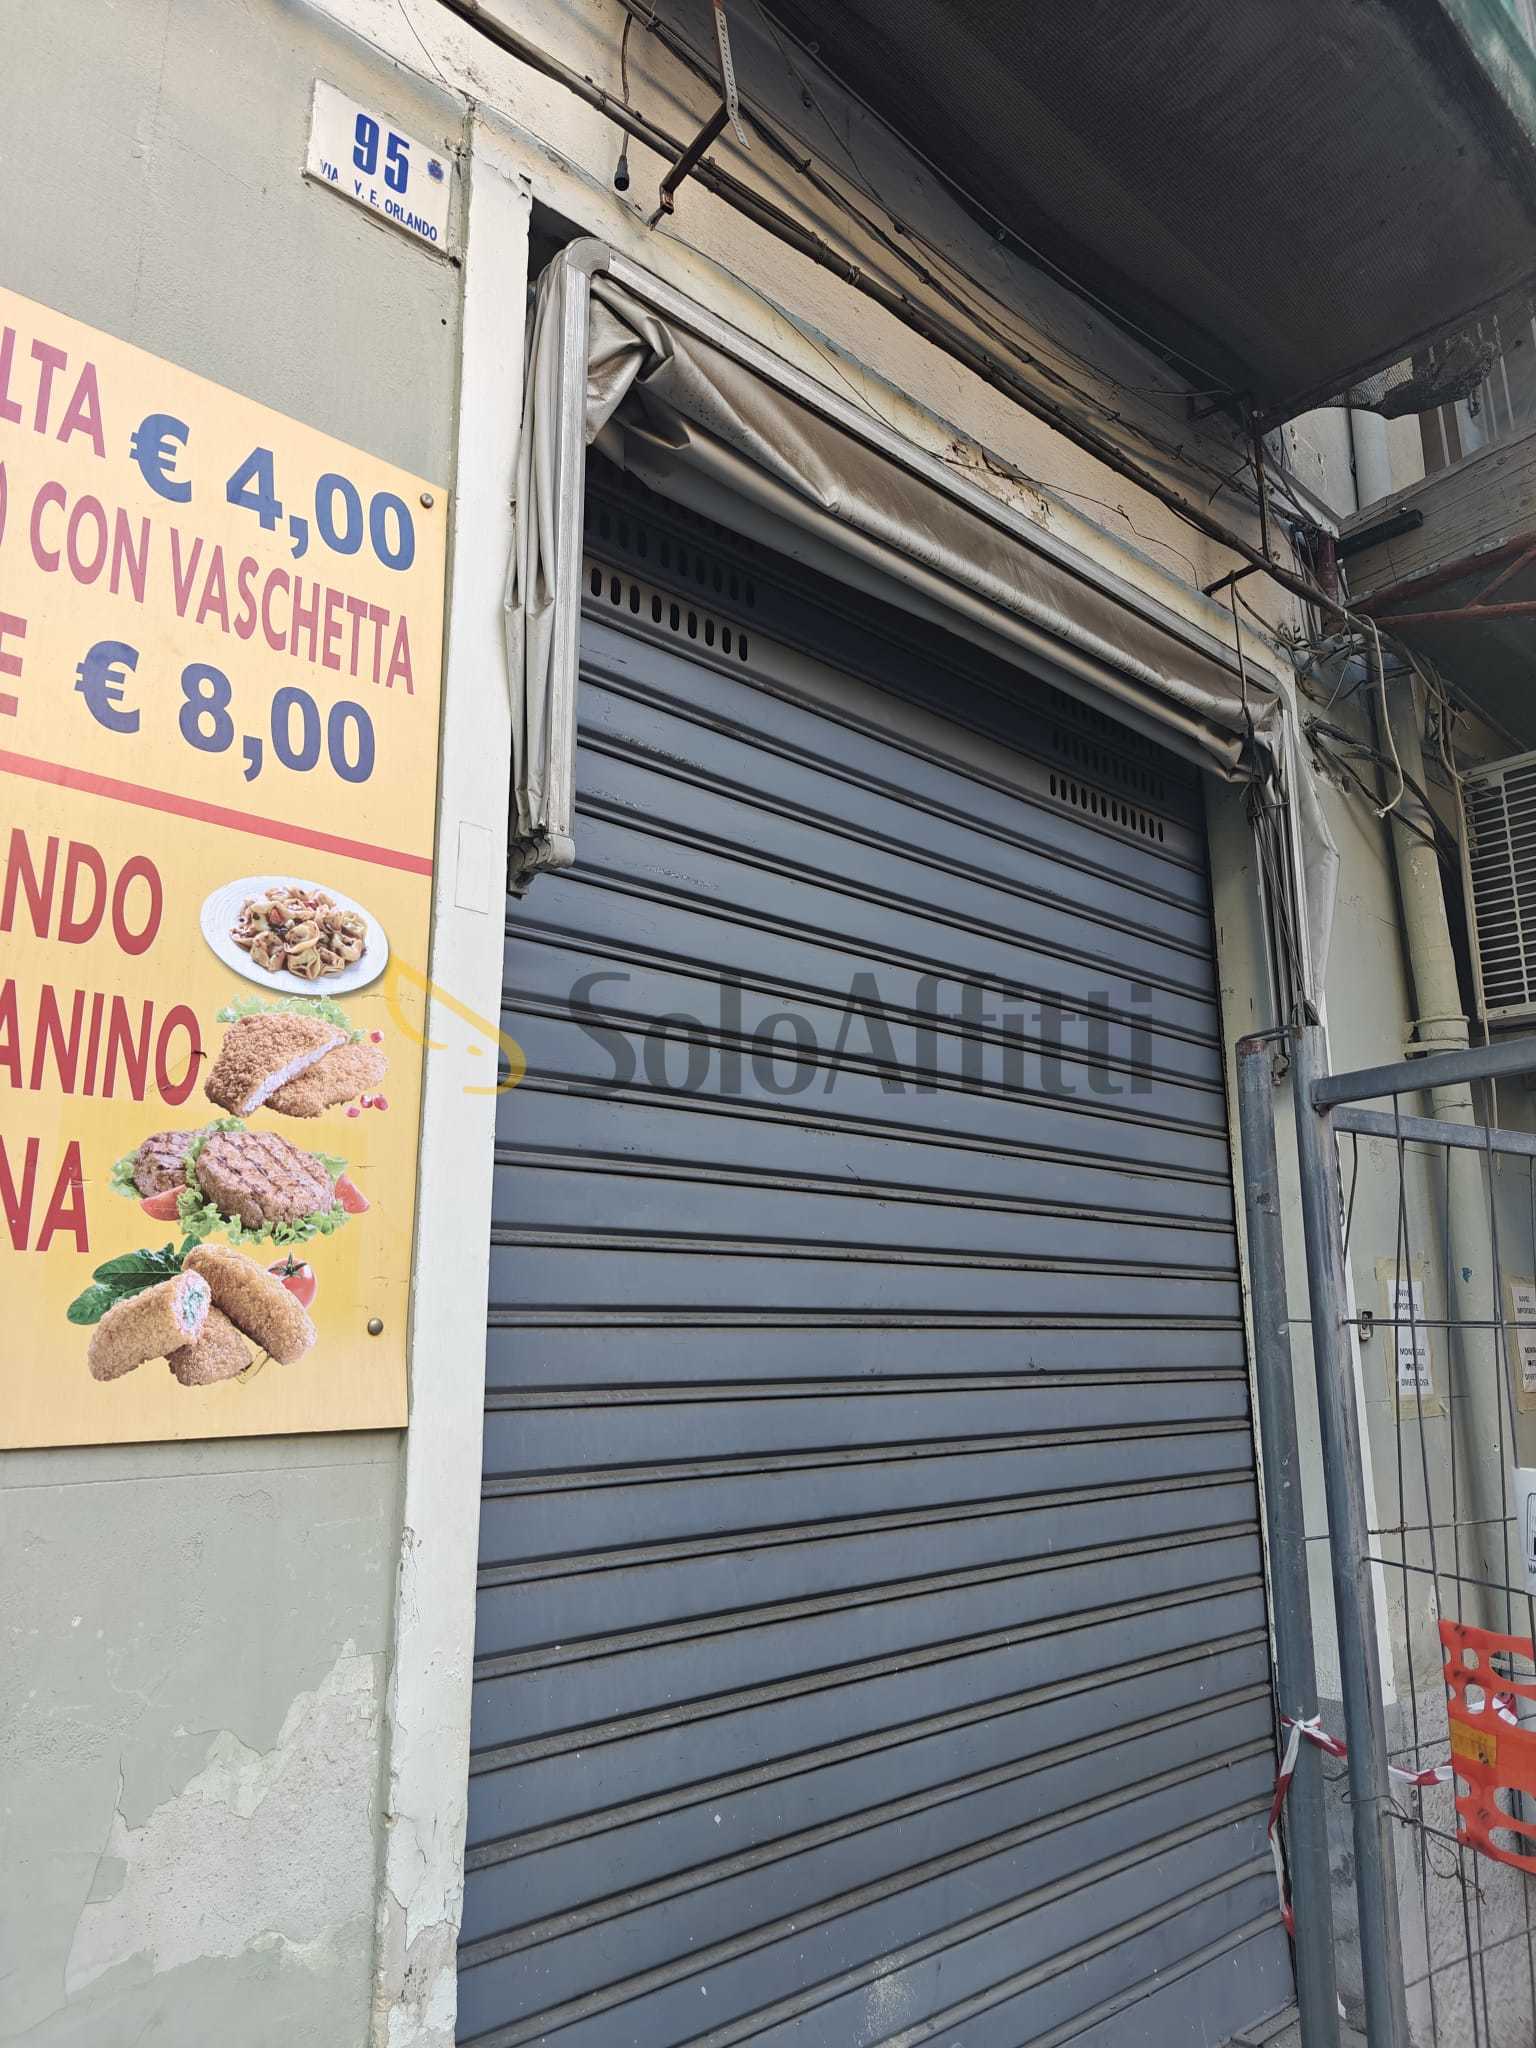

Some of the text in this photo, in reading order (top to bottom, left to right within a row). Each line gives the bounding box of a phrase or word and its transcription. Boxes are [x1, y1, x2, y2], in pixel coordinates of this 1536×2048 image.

[320, 159, 438, 241] VIA V. E. ORLANDO
[353, 113, 410, 194] 95
[129, 413, 192, 504] €
[226, 446, 416, 572] 4,00
[30, 481, 151, 604] CON
[170, 527, 414, 695] VASCHETTA
[74, 640, 141, 735] €
[178, 662, 376, 784] 8,00
[0, 828, 163, 956] NDO
